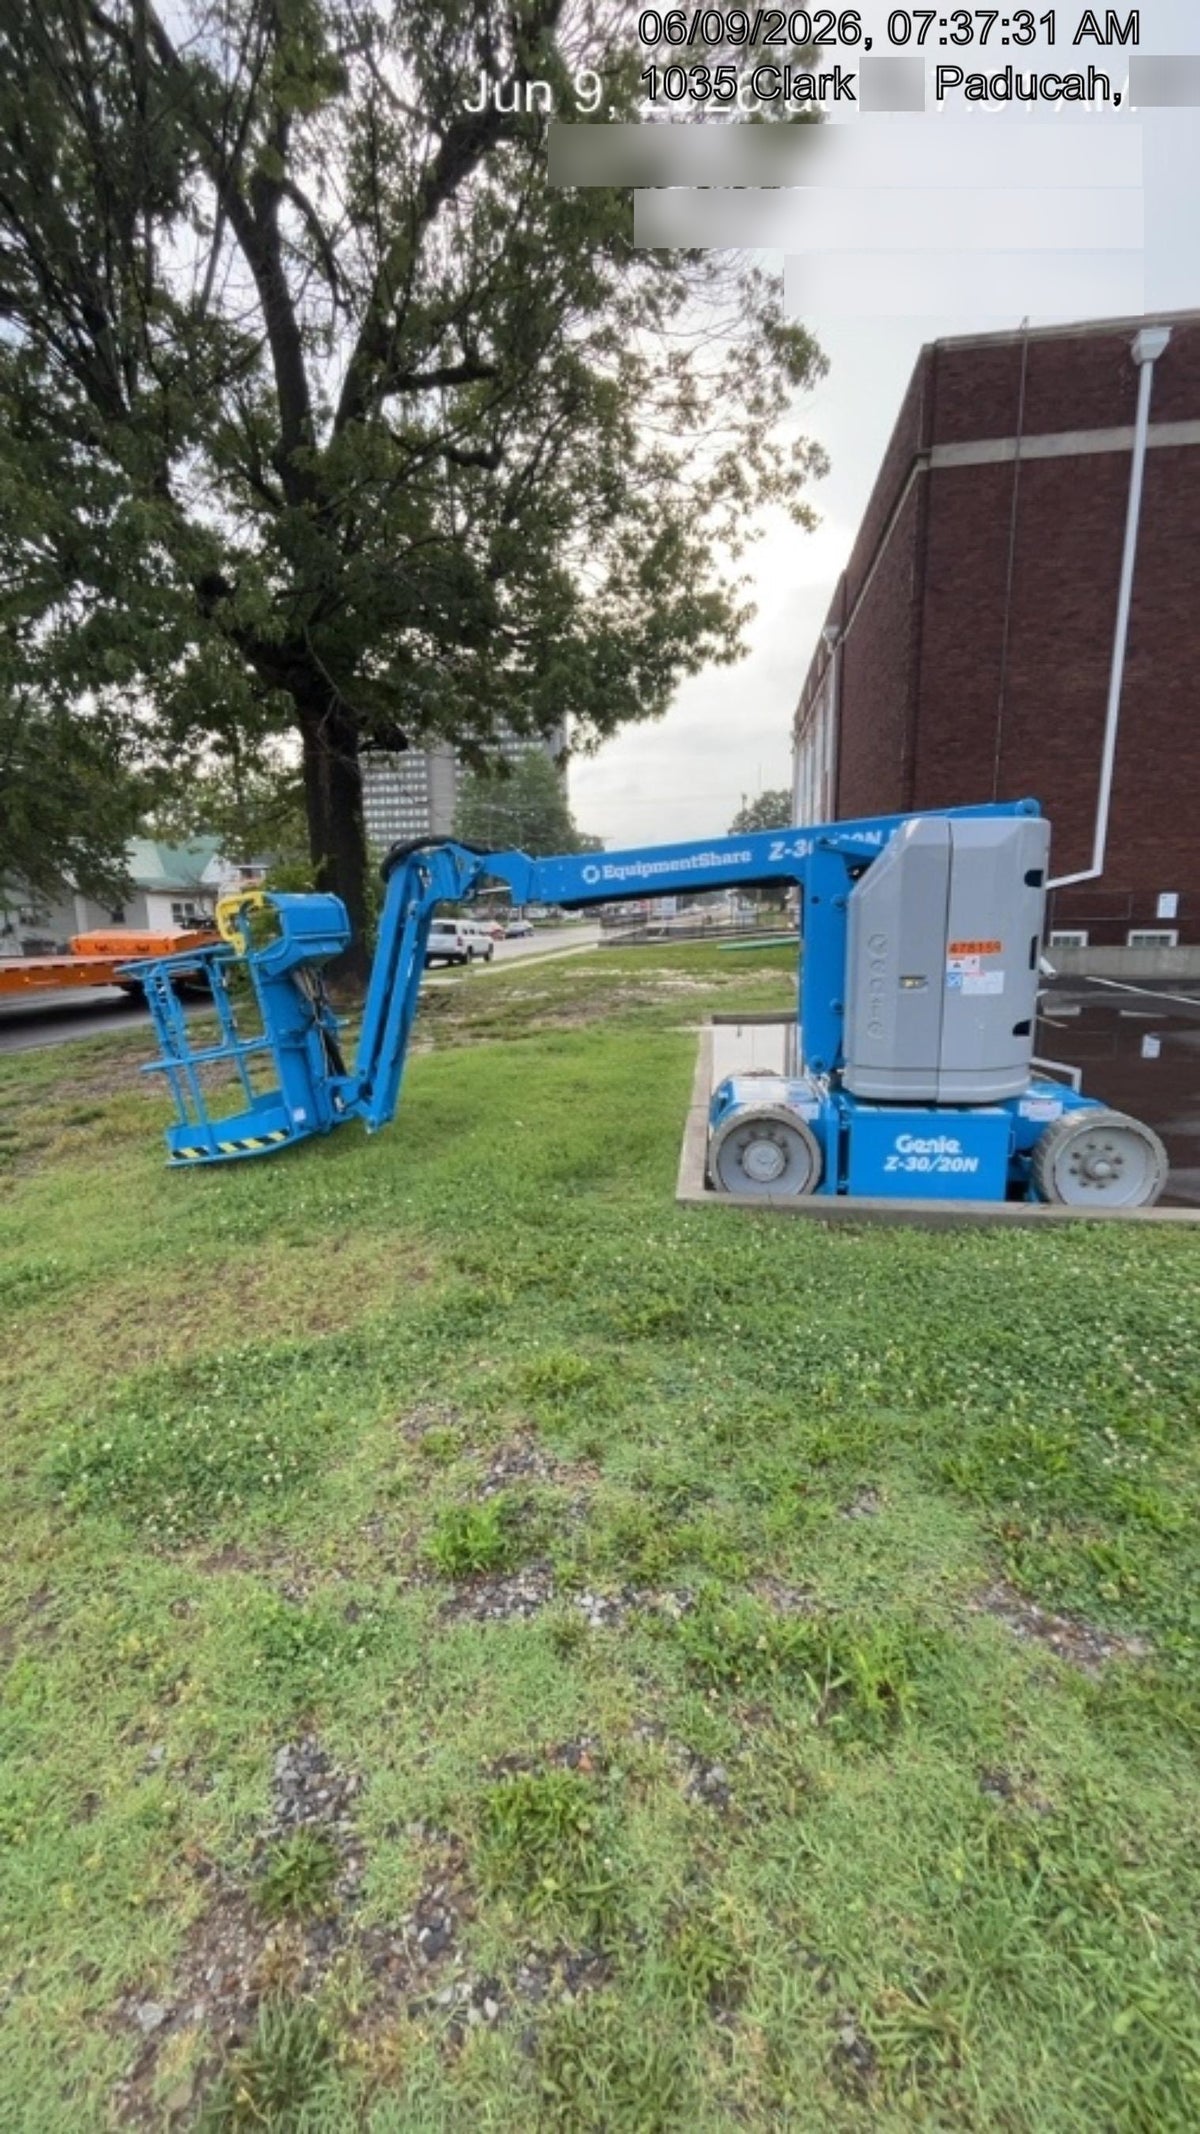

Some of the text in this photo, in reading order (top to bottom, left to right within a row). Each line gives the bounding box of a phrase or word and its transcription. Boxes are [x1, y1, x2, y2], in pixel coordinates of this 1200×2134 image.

[603, 851, 752, 881] EquipmentShare
[896, 1134, 961, 1153] Genie
[884, 1155, 979, 1172] Z-30/20N
